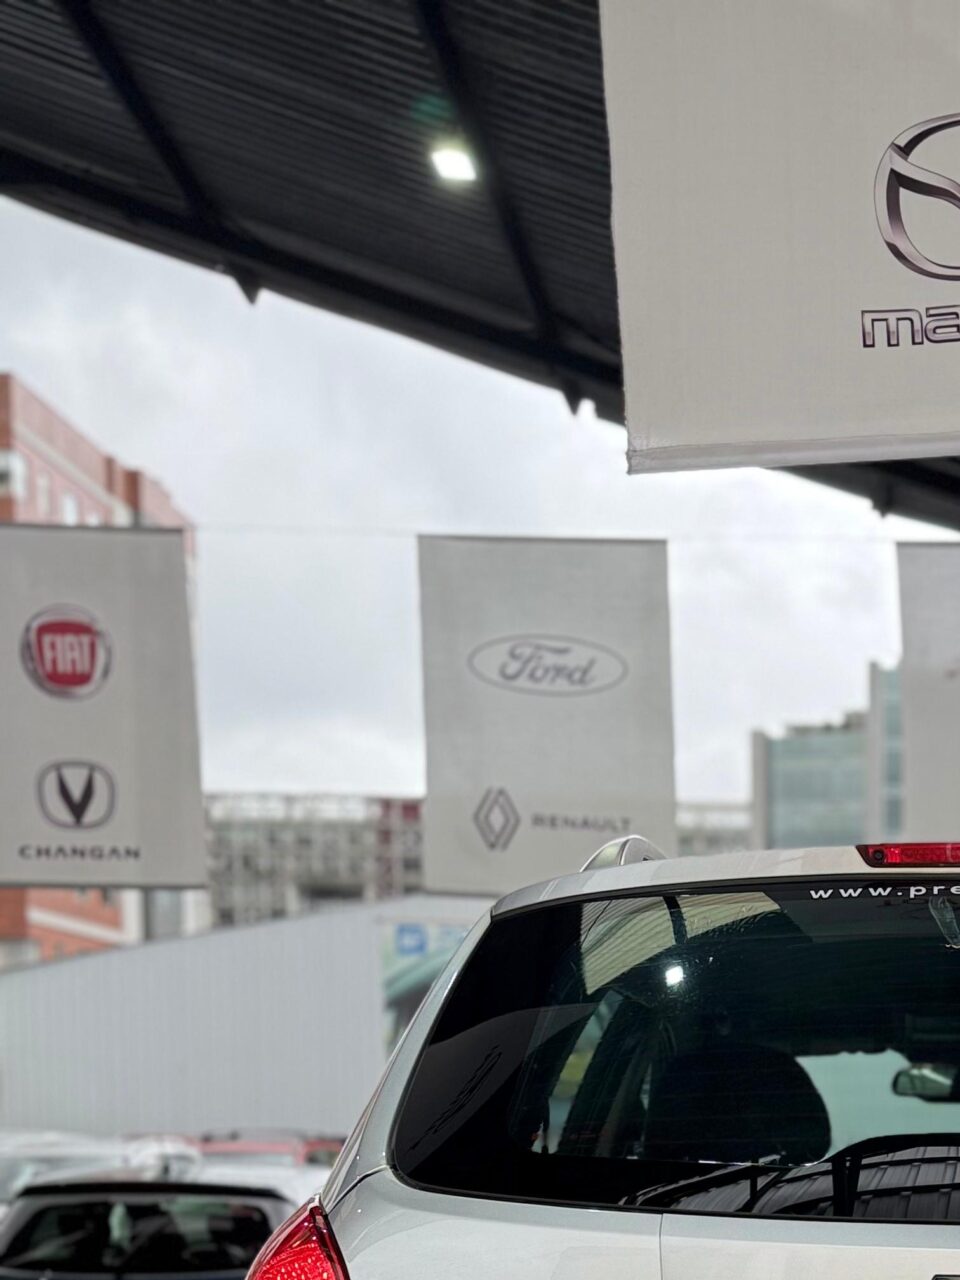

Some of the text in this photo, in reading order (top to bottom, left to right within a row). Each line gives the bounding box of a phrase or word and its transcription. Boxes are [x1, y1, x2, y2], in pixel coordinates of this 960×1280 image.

[41, 633, 92, 675] FIAT
[499, 640, 597, 685] Ford
[532, 814, 632, 832] RENAULT
[18, 845, 141, 859] CHANGAN
